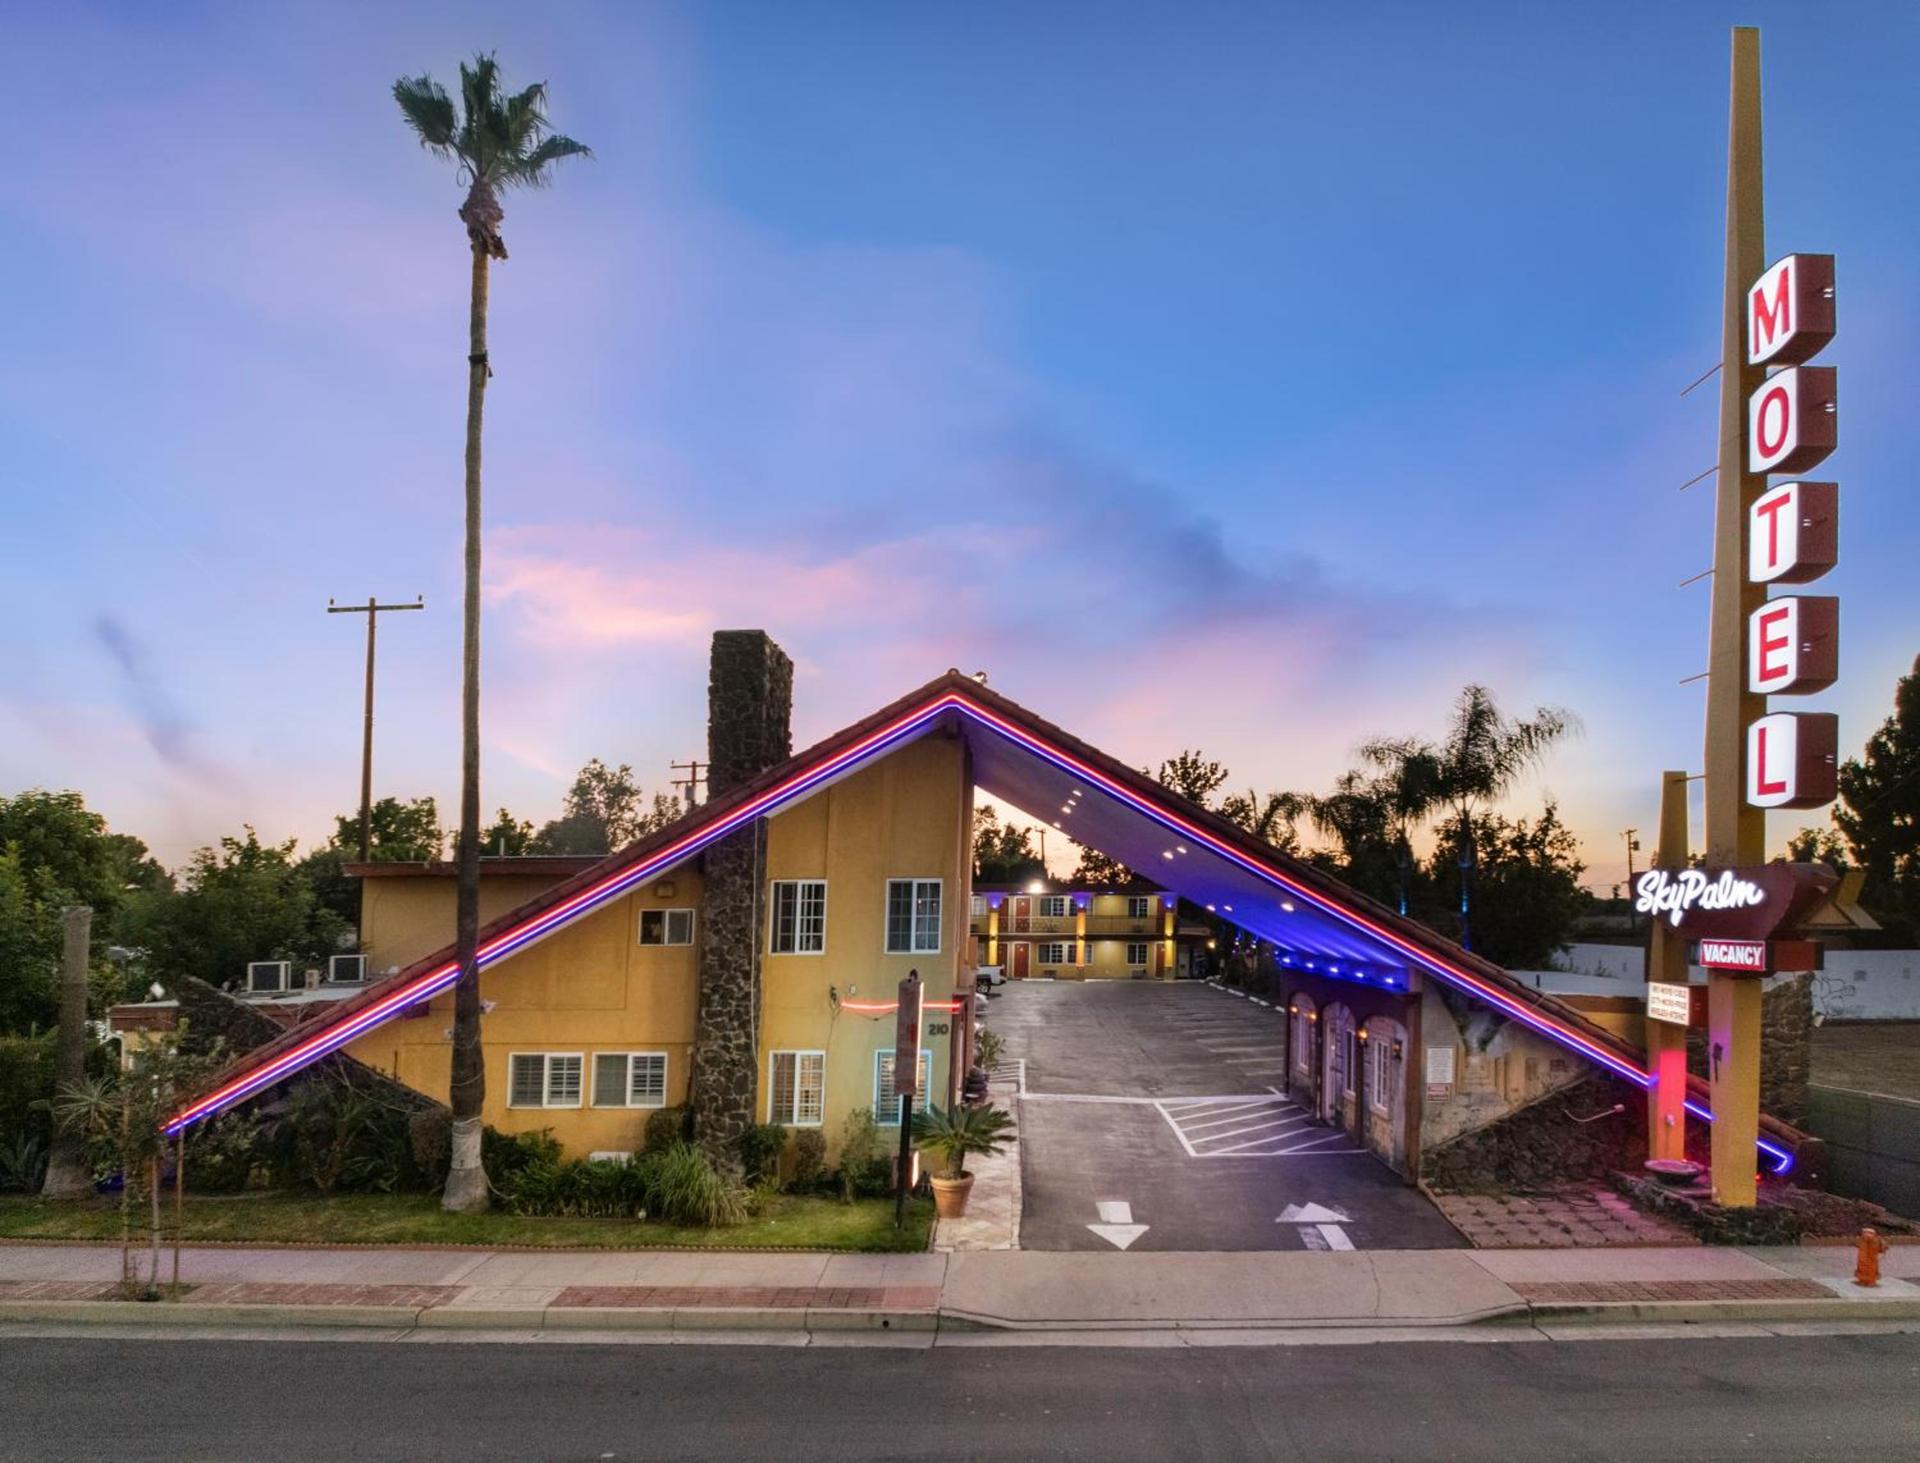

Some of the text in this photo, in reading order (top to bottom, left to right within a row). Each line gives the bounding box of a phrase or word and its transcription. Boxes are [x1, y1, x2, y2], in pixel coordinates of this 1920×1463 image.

[1753, 265, 1791, 796] MOTEL
[1703, 943, 1763, 966] VACANCY
[929, 1023, 949, 1036] 210
